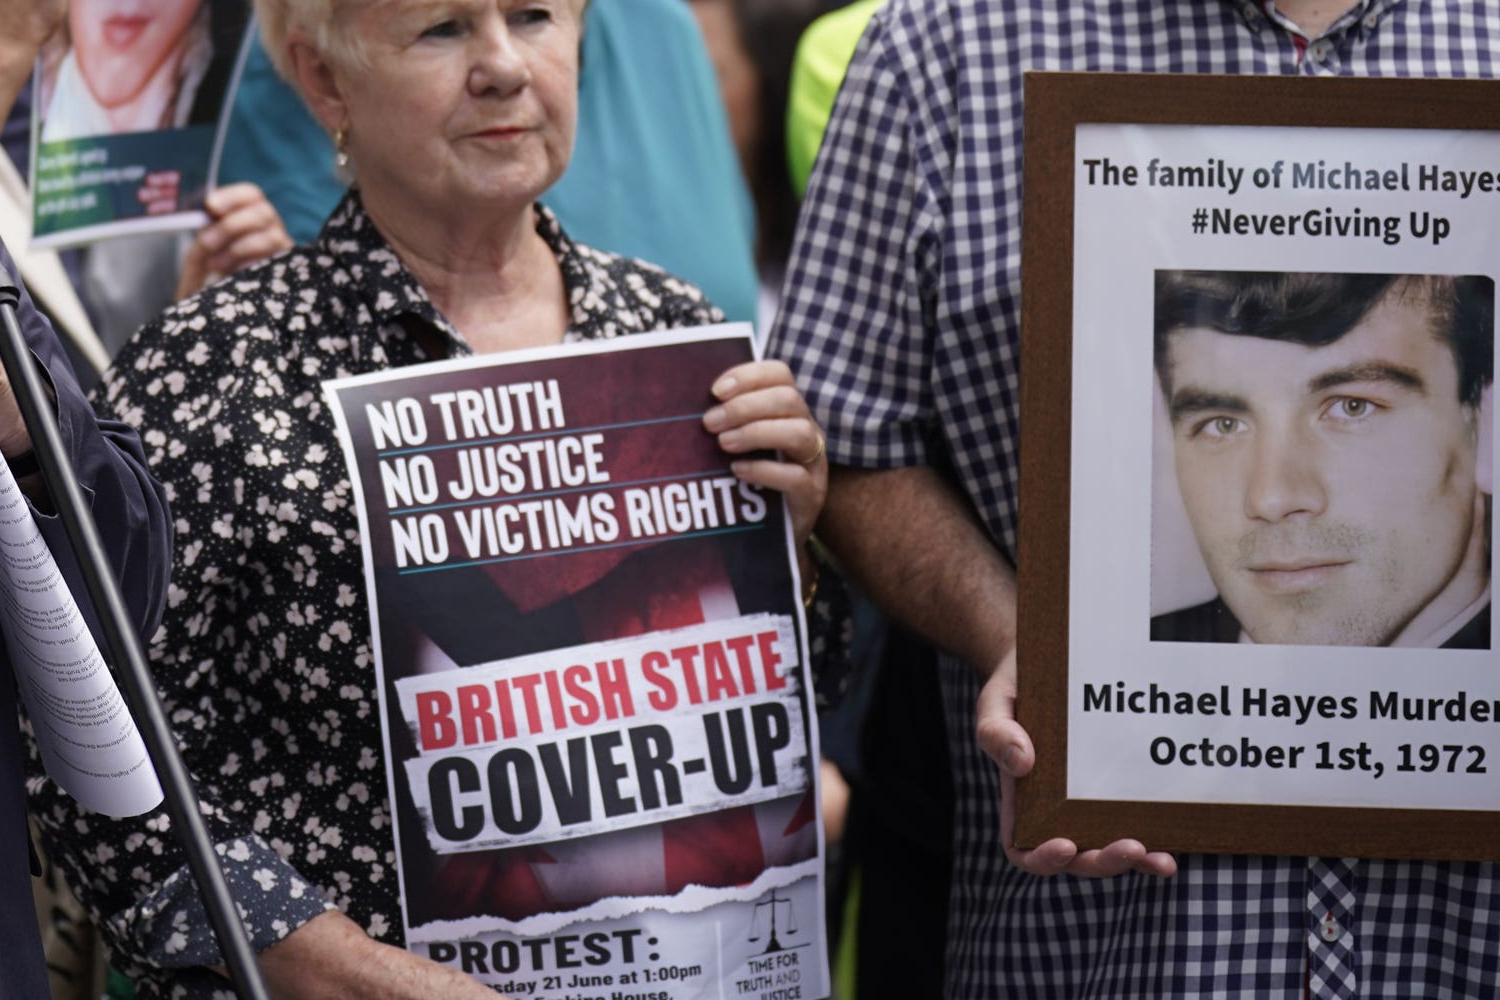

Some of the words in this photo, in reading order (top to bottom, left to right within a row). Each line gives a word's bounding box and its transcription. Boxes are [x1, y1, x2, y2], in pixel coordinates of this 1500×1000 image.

[1083, 157, 1139, 187] The
[1147, 158, 1245, 195] family
[1252, 160, 1285, 189] of
[1291, 160, 1410, 192] Michael
[1418, 164, 1500, 199] Haye
[1191, 206, 1402, 245] #NeverGiving
[1409, 210, 1451, 245] Up
[364, 397, 428, 451] NO
[430, 379, 566, 442] TRUTH
[378, 454, 438, 509] NO
[447, 433, 610, 501] JUSTICE
[390, 513, 450, 568] NO
[454, 491, 621, 560] VICTIMS
[623, 477, 768, 539] RIGHTS
[415, 658, 638, 753] BRITISH
[641, 630, 788, 715] STATE
[1082, 681, 1232, 716] Michael
[1242, 687, 1359, 725] Hayes
[426, 700, 791, 844] COVER-UP
[1149, 736, 1305, 769] October
[1315, 741, 1385, 779] 1st,
[1396, 742, 1487, 774] 1972
[428, 928, 660, 975] PROTEST:
[748, 956, 774, 975] TIME
[776, 952, 799, 969] FOR
[543, 974, 562, 990] 21
[567, 971, 613, 989] June
[619, 970, 638, 986] at
[643, 964, 702, 984] 1:00pm
[735, 973, 772, 995] TRUTH
[775, 969, 801, 985] AND
